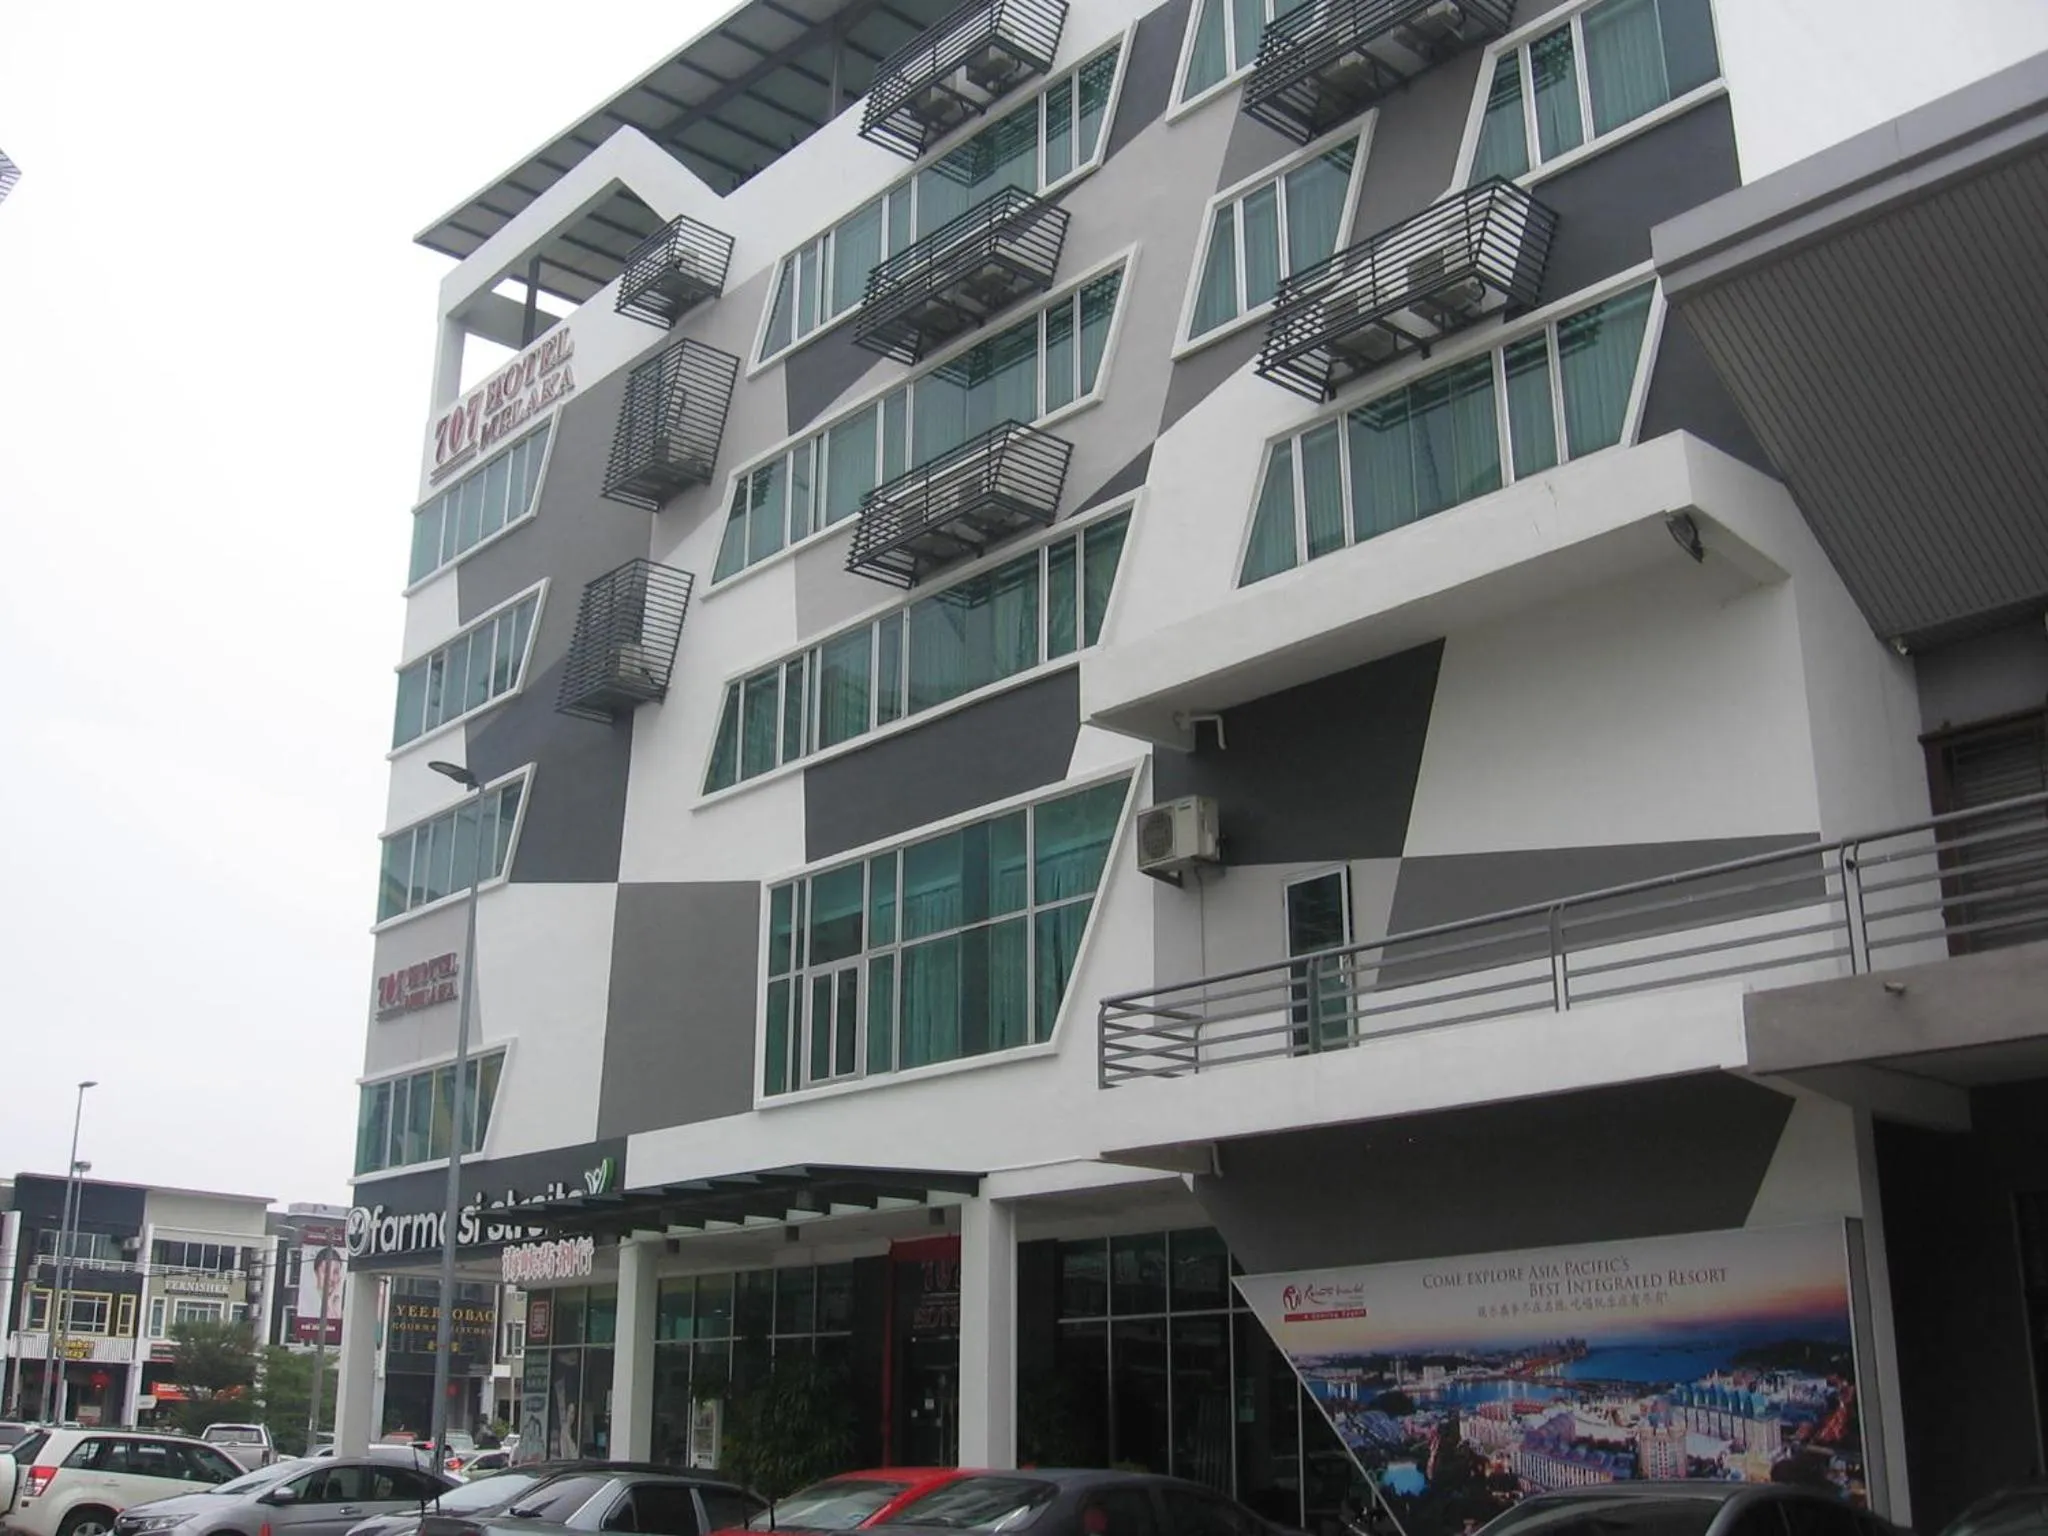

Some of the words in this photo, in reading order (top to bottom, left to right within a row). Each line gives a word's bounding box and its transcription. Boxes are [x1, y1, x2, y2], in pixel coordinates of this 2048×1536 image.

[434, 391, 484, 465] 707
[484, 327, 574, 417] HOTEL
[479, 364, 576, 451] MELAKA
[1422, 1273, 1463, 1290] COME
[1467, 1267, 1524, 1286] EXPLORE
[1528, 1264, 1560, 1280] ASIA
[1529, 1282, 1560, 1298] BEST
[1566, 1273, 1662, 1294] INTEGRATED
[1668, 1267, 1728, 1287] RESORT
